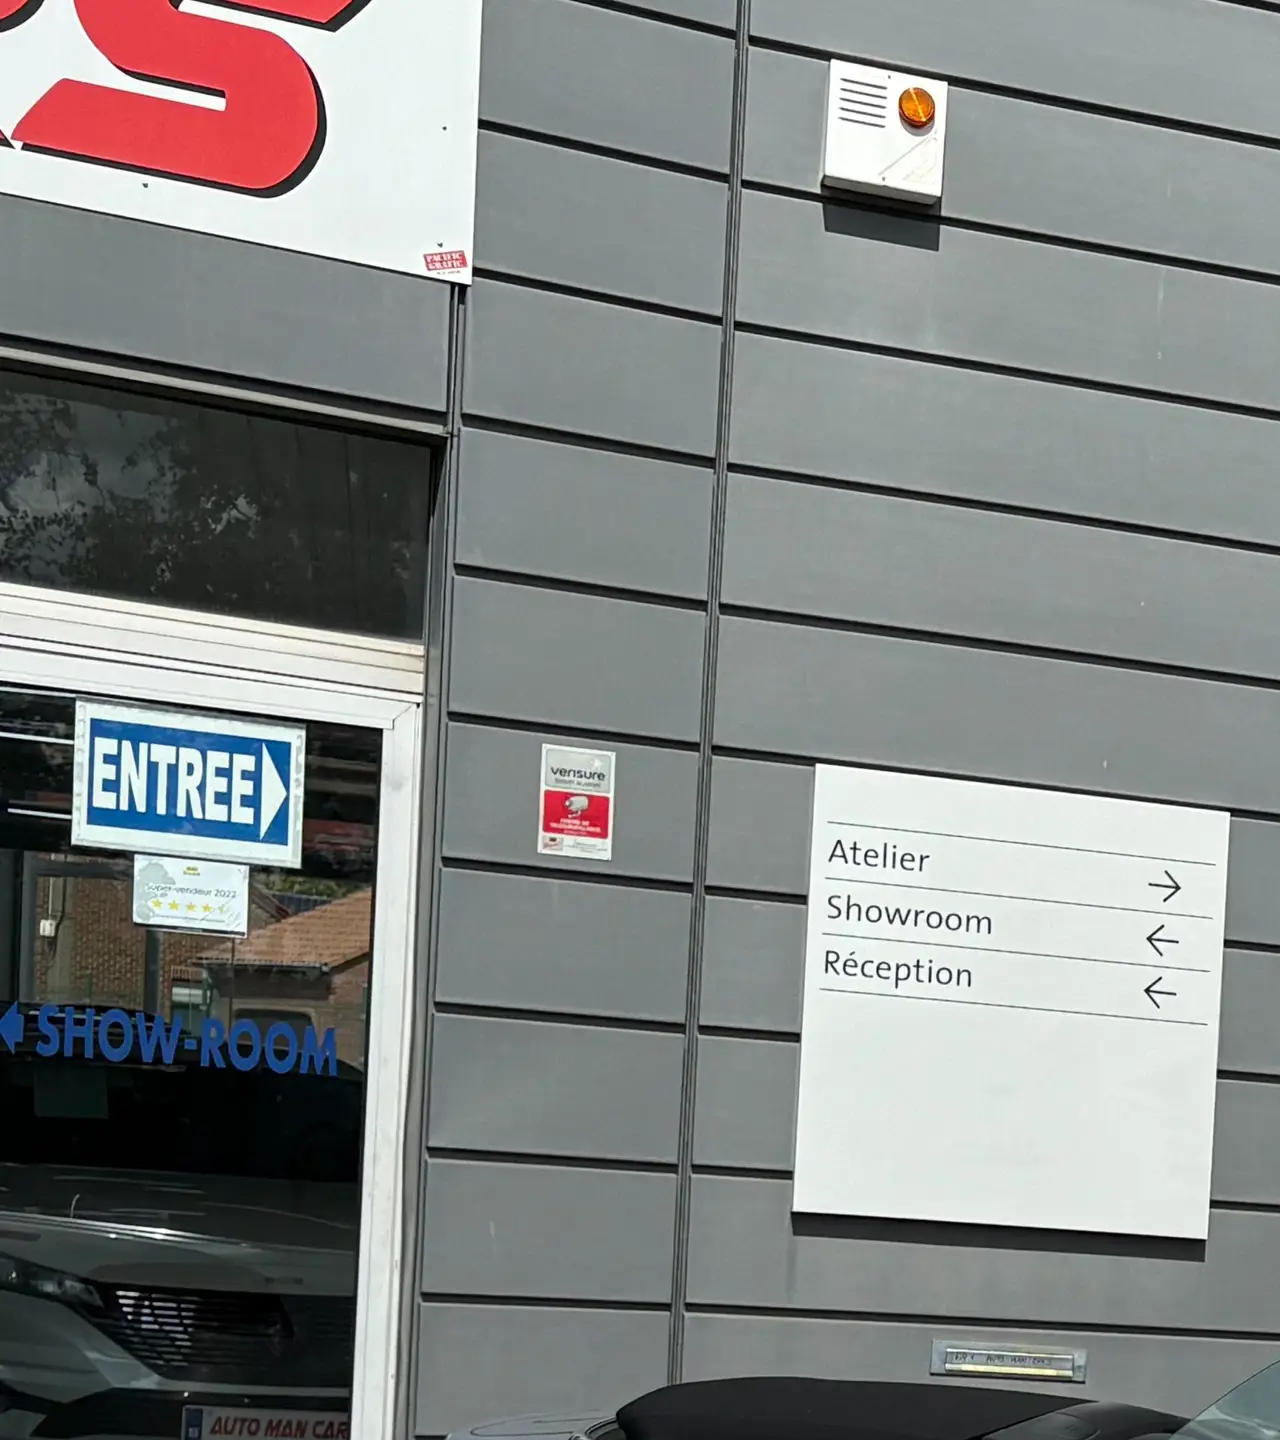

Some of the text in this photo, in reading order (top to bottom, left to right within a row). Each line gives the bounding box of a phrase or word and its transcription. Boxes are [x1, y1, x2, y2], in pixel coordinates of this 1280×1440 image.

[0, 0, 360, 198] S
[92, 736, 256, 825] ENTREE
[828, 839, 931, 872] Atelier
[214, 888, 237, 899] 2022
[827, 894, 992, 935] Showroom
[824, 949, 972, 990] Réception
[36, 1003, 338, 1077] SHOW-ROOM
[210, 1416, 261, 1437] AUTO
[264, 1418, 308, 1439] MAN
